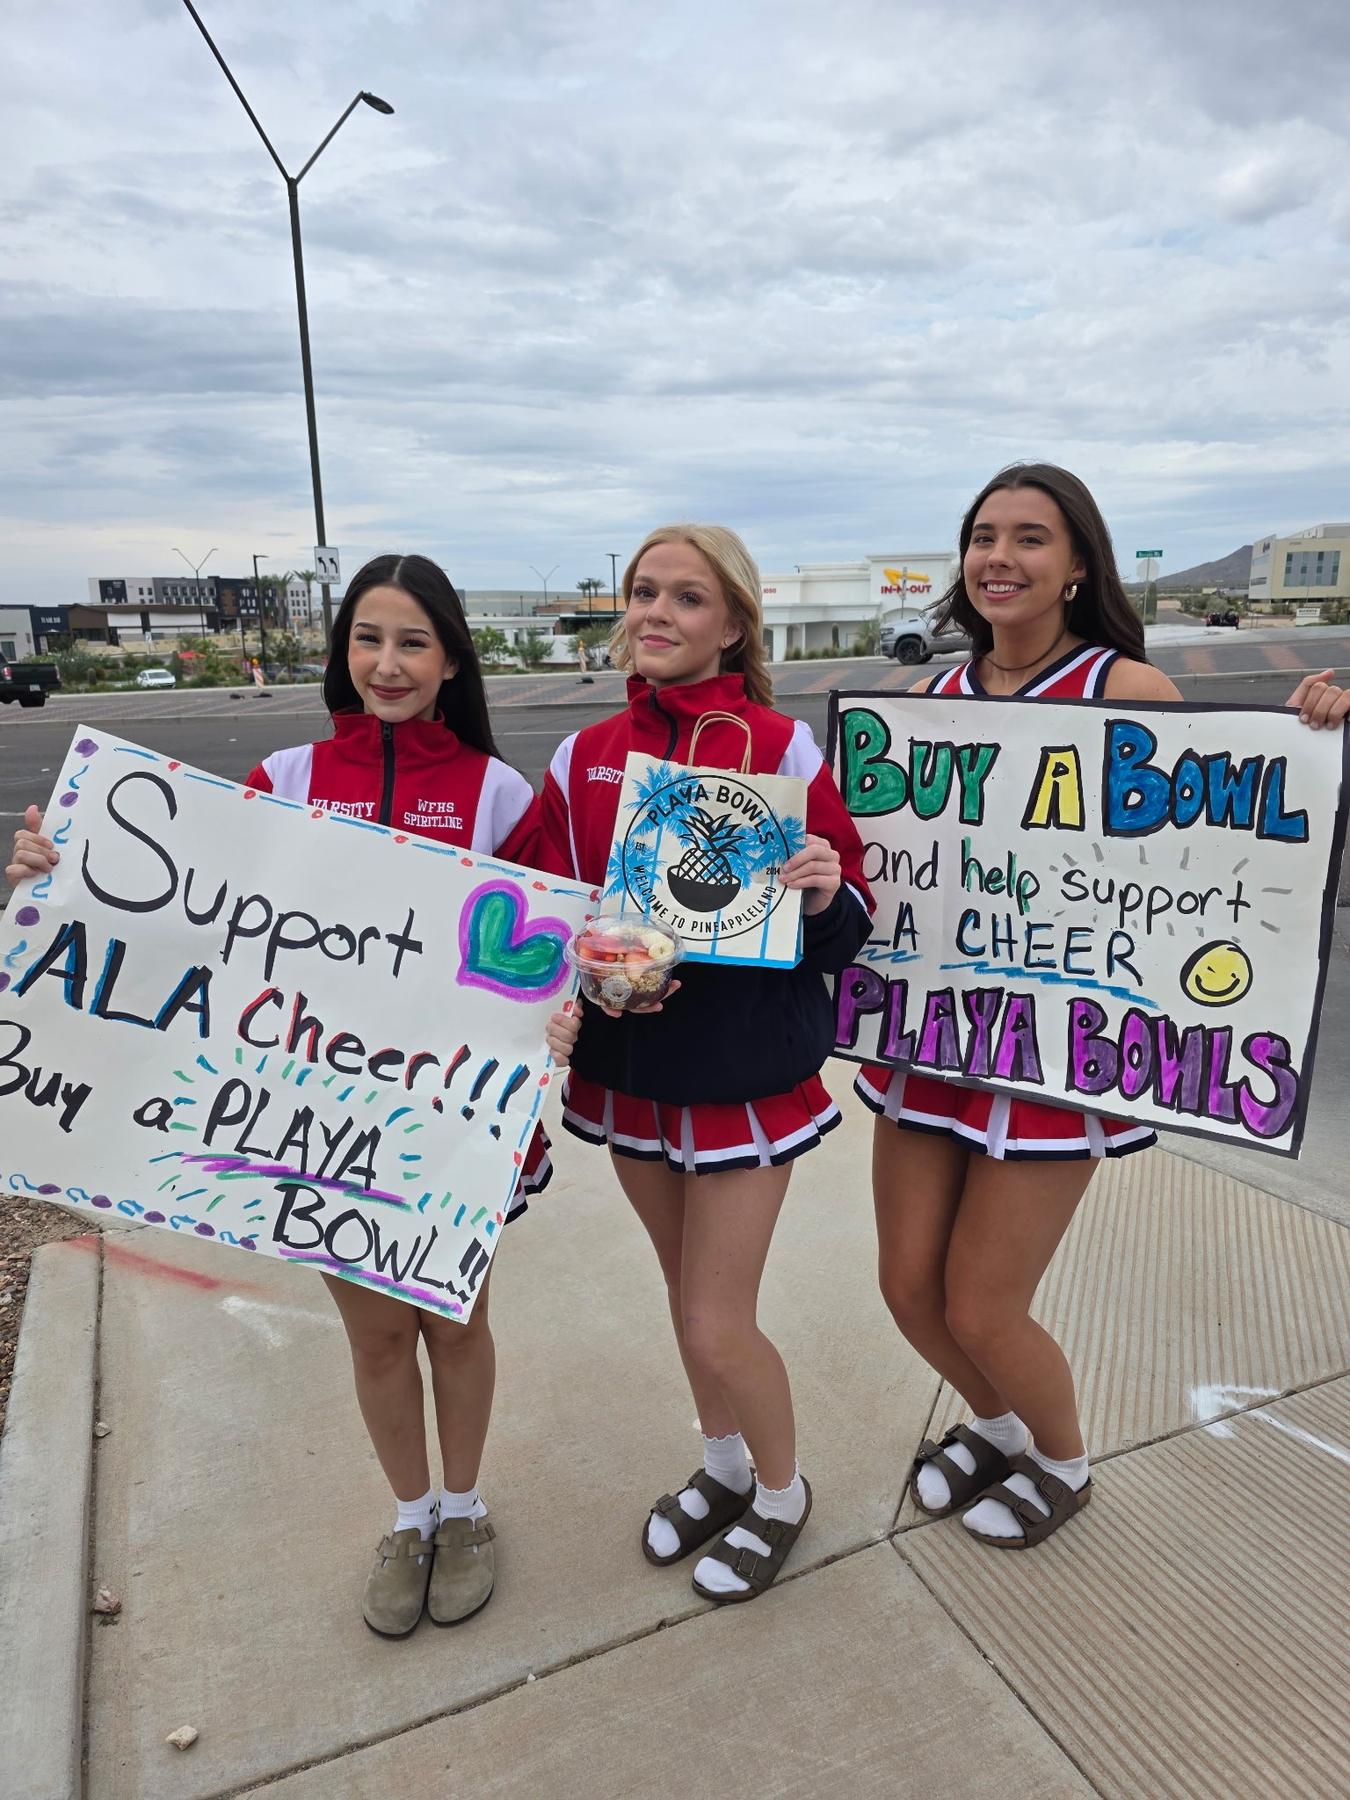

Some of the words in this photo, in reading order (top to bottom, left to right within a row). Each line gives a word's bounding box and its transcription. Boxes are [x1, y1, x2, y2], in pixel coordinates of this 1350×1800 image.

[312, 799, 375, 818] VARSITY
[418, 799, 455, 813] WFHS
[647, 784, 709, 826] PLAYA
[716, 785, 775, 845] BOWLS
[839, 707, 1000, 824] BUY
[1021, 745, 1085, 831] A
[1103, 718, 1309, 843] BOWL
[403, 811, 463, 830] SPIRITLINE
[81, 771, 423, 982] Support
[633, 865, 669, 918] WELCOME
[670, 914, 686, 929] TO
[691, 885, 777, 934] PINEAPPLELAND
[863, 841, 939, 888] and
[960, 837, 1041, 913] help
[1061, 869, 1252, 935] support
[10, 920, 214, 1039] ALA
[955, 904, 1144, 987] CHEER
[834, 963, 1045, 1085] PLAYA
[1066, 997, 1301, 1137] BOWLS
[133, 1097, 173, 1133] a
[202, 1078, 382, 1191] PLAYA
